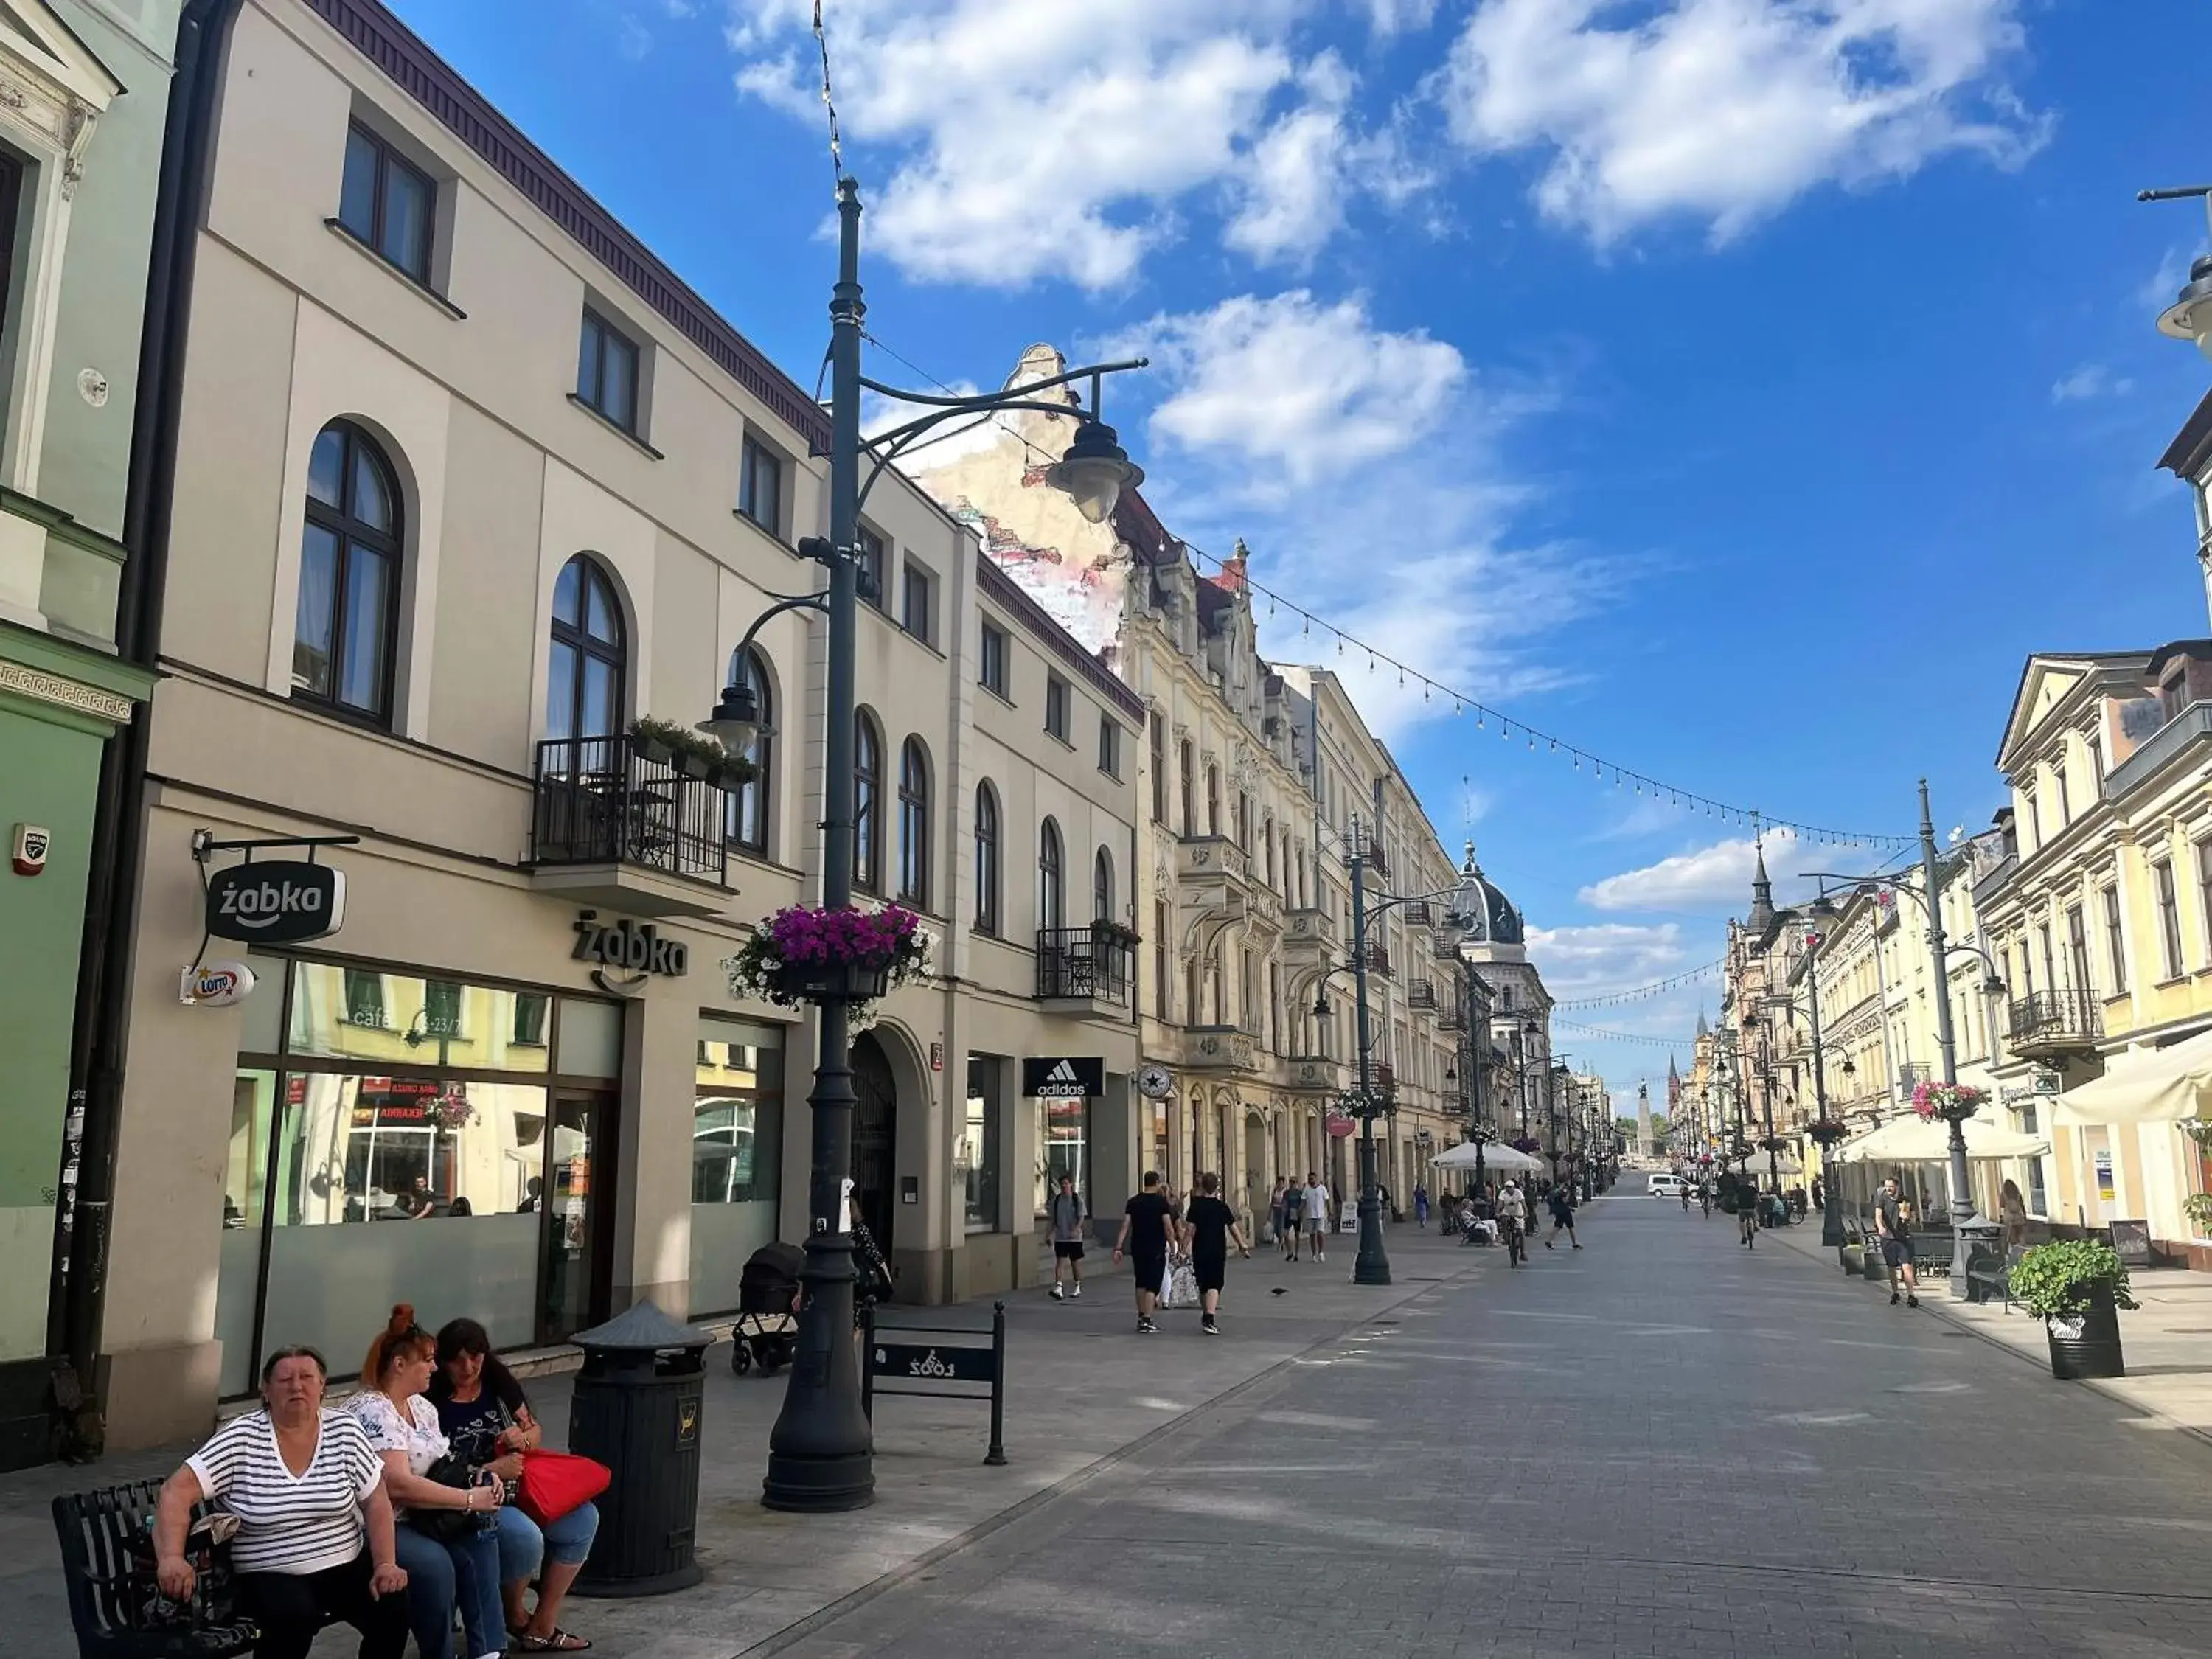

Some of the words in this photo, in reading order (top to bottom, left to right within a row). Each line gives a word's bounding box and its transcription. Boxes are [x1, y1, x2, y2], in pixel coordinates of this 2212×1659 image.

[220, 880, 322, 914] żabka
[572, 909, 689, 976] żabka
[201, 975, 228, 993] LOTTO
[1037, 1083, 1085, 1095] adidas
